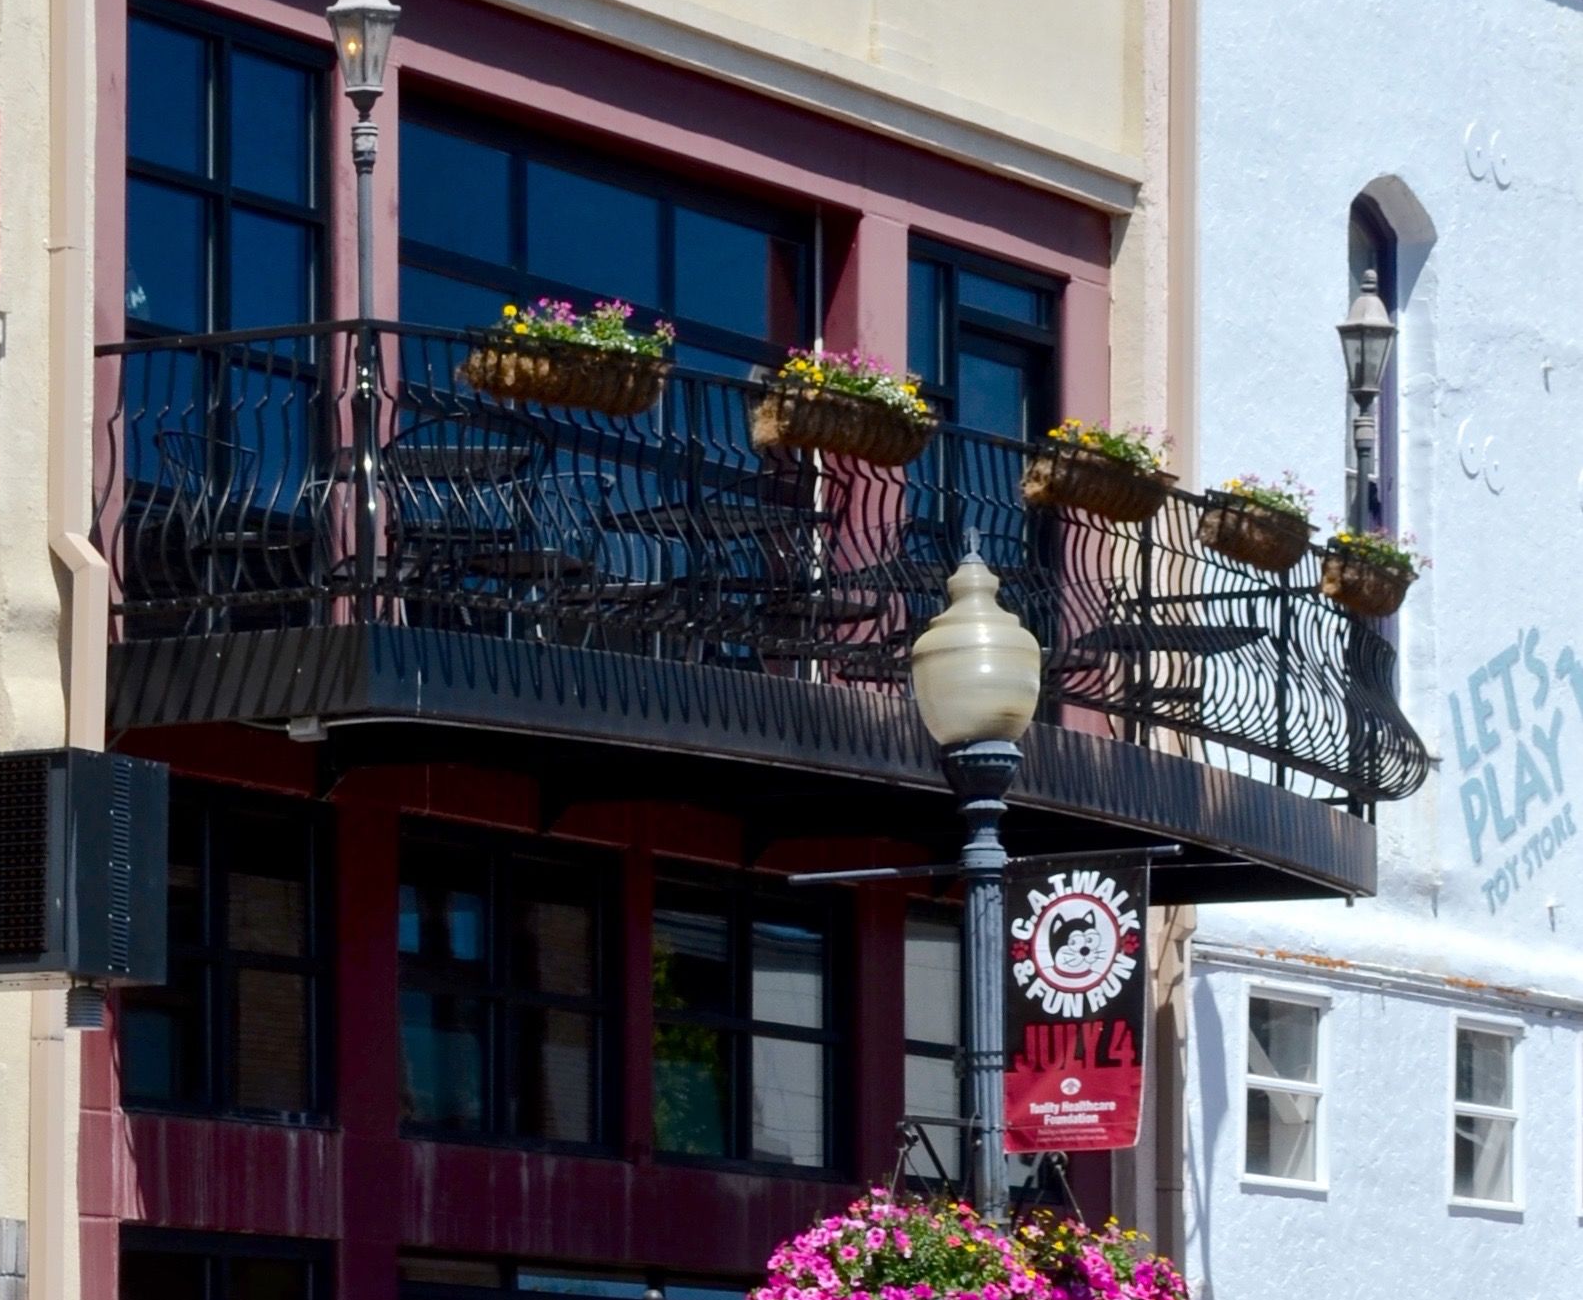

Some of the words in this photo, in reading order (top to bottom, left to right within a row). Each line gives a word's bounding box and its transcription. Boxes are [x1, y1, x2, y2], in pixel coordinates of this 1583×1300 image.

[1448, 626, 1550, 771] LET'S
[1459, 707, 1564, 866] PLAY
[1481, 854, 1521, 916] TOY
[1520, 801, 1578, 882] STORE
[1025, 977, 1084, 1018] FUN
[1085, 951, 1137, 1013] RUN
[1015, 1020, 1103, 1070] JULY
[1108, 1019, 1136, 1068] 4
